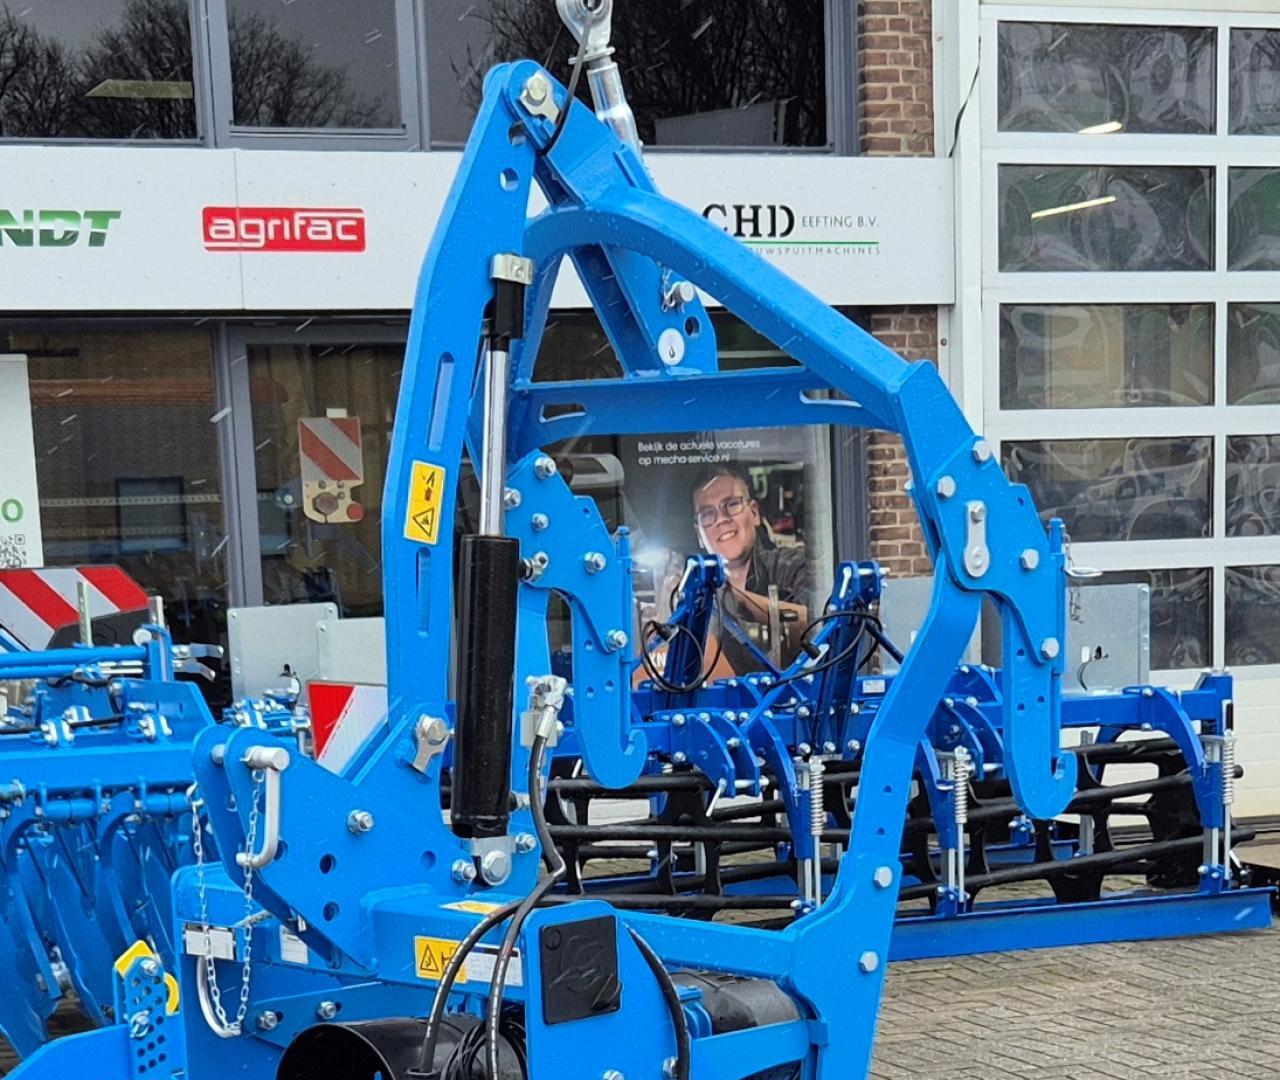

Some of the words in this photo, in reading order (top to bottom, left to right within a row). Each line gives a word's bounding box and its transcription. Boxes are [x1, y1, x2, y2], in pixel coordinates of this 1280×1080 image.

[801, 215, 853, 228] EEFTING
[857, 215, 880, 228] B.V.
[204, 211, 365, 248] agrifac
[750, 246, 880, 256] UWSPUITMACHINES
[637, 442, 663, 453] Bekijk
[665, 442, 679, 451] de
[716, 440, 760, 450] vacatures
[638, 456, 652, 467] op
